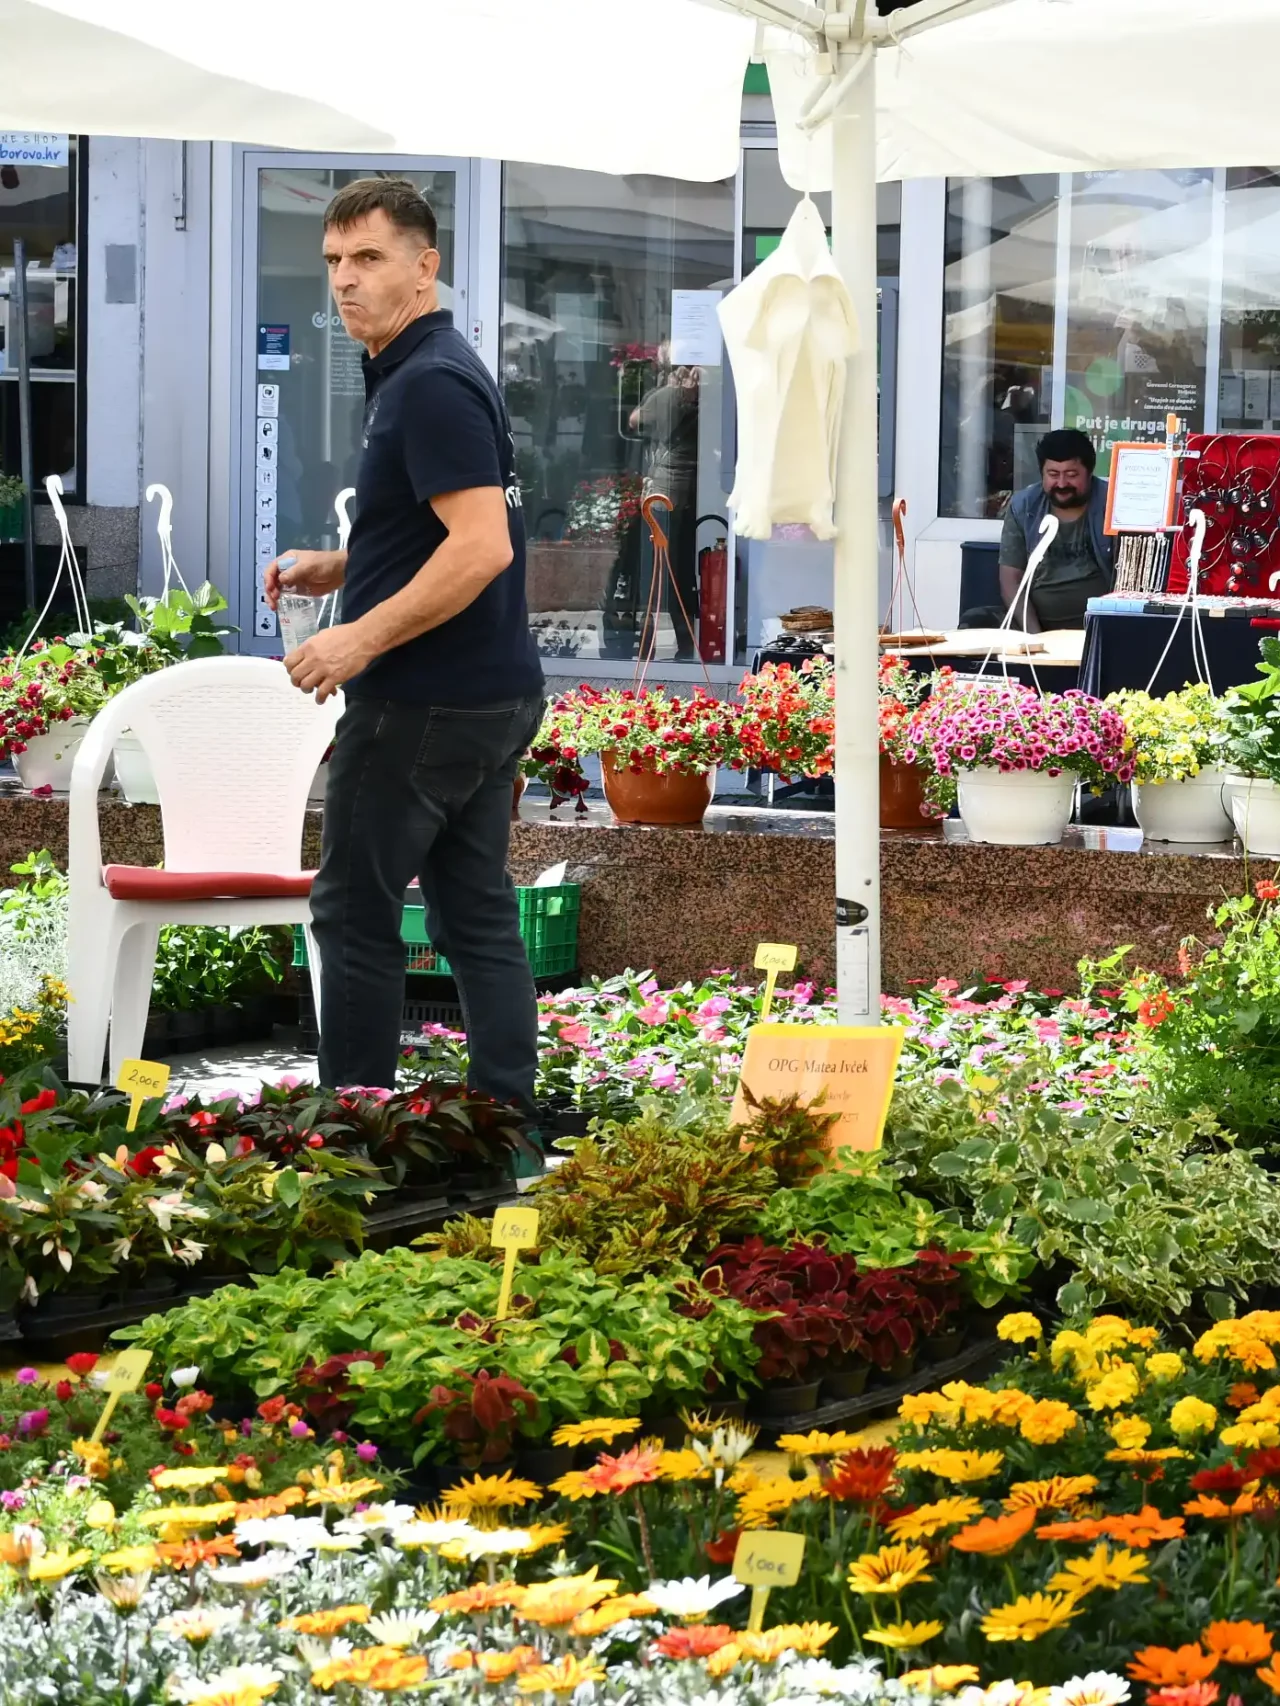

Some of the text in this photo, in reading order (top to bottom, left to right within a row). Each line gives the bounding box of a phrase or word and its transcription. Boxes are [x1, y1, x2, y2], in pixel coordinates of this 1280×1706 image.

[23, 133, 58, 144] SHOP
[1076, 415, 1102, 429] Put
[1103, 415, 1119, 432] je
[768, 1058, 799, 1072] OPG
[802, 1060, 836, 1073] Matea
[127, 1069, 160, 1088] 2,00€
